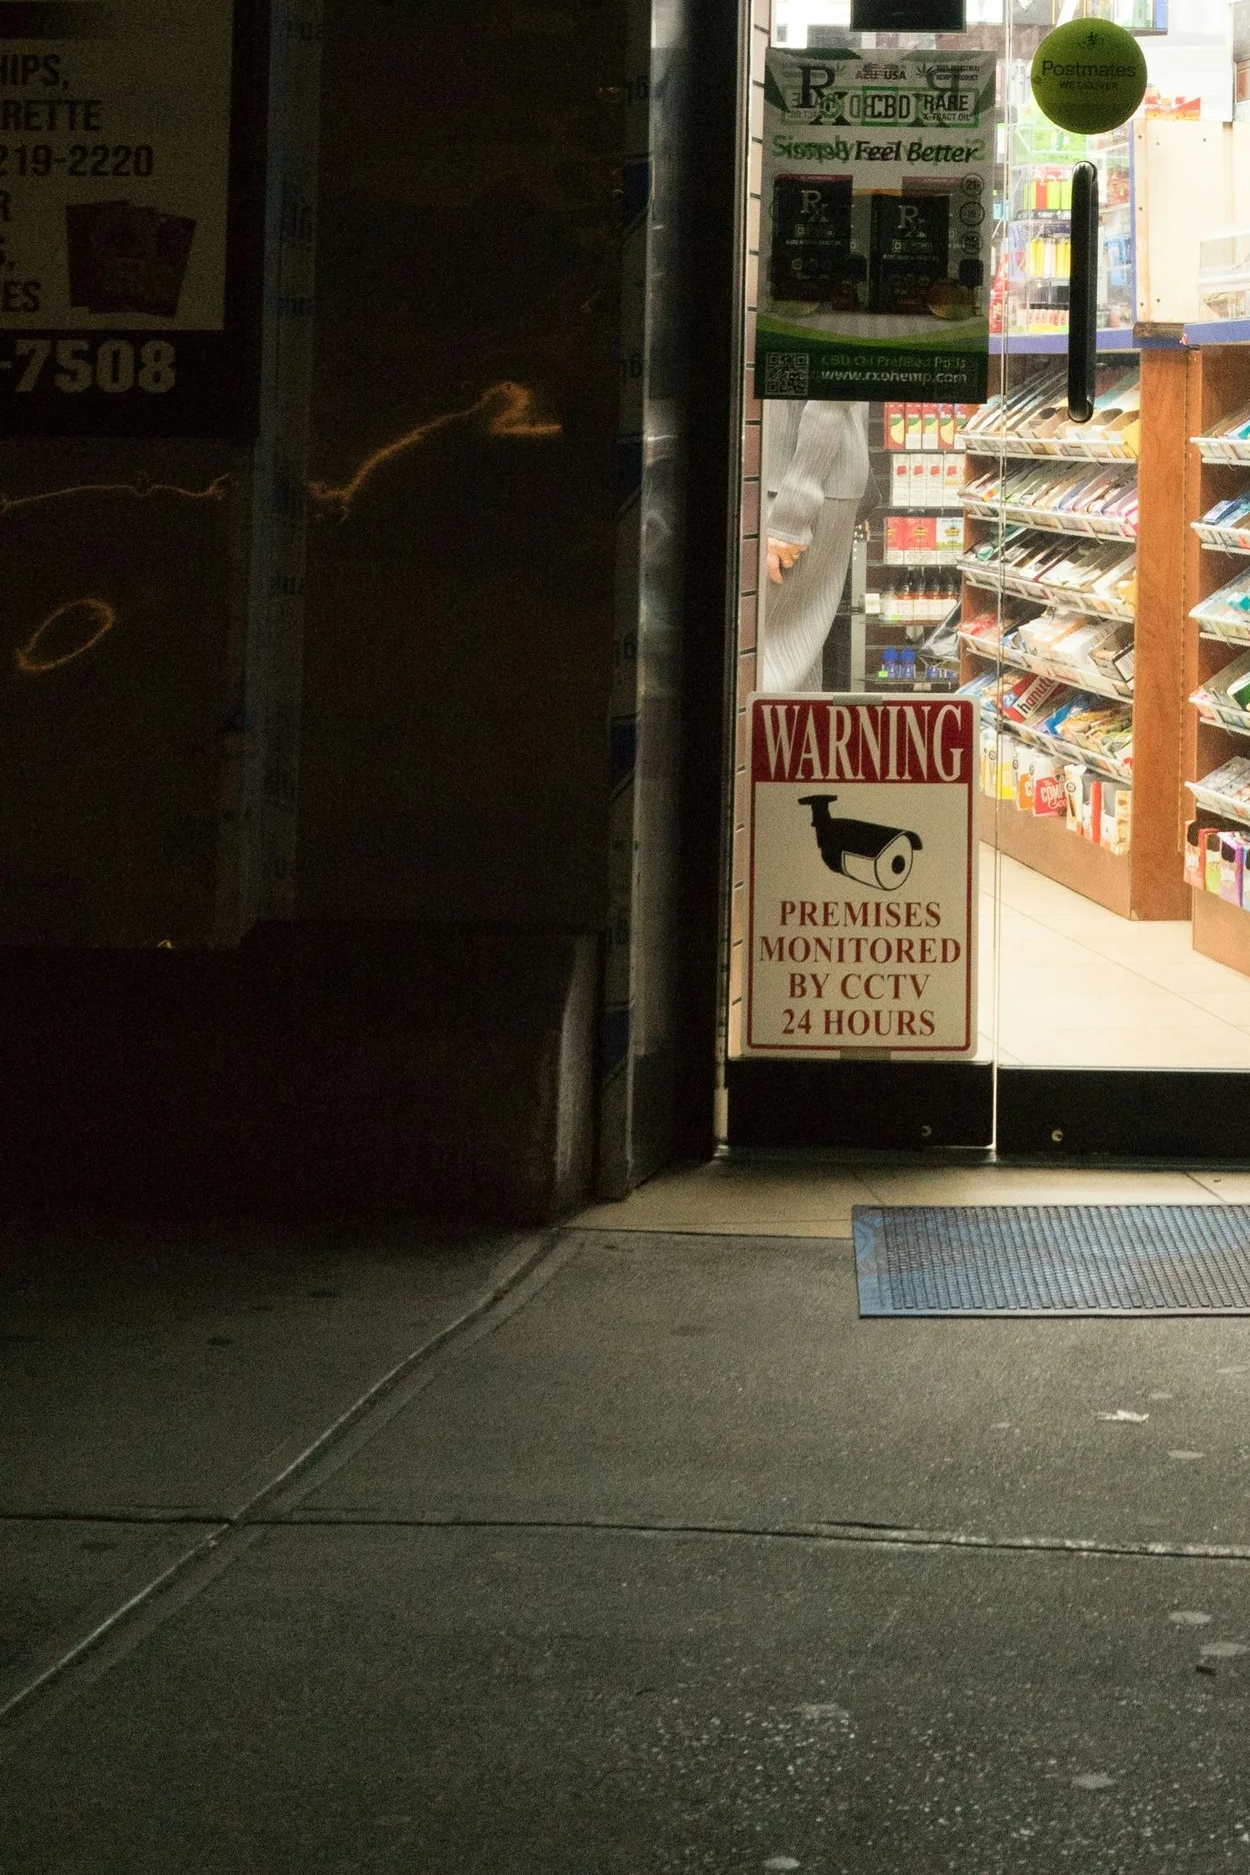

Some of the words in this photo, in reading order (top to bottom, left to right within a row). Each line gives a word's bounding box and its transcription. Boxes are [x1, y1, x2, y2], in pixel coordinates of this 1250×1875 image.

[1042, 60, 1137, 78] Postmates
[855, 139, 903, 162] Feel
[906, 140, 980, 163] Better
[761, 703, 964, 782] WARNING
[778, 900, 942, 928] PREMISES
[759, 935, 961, 965] MONITORED
[788, 972, 831, 999] BY
[840, 972, 931, 1000] CCTV
[782, 1008, 812, 1036] 24
[823, 1009, 936, 1037] HOURS
